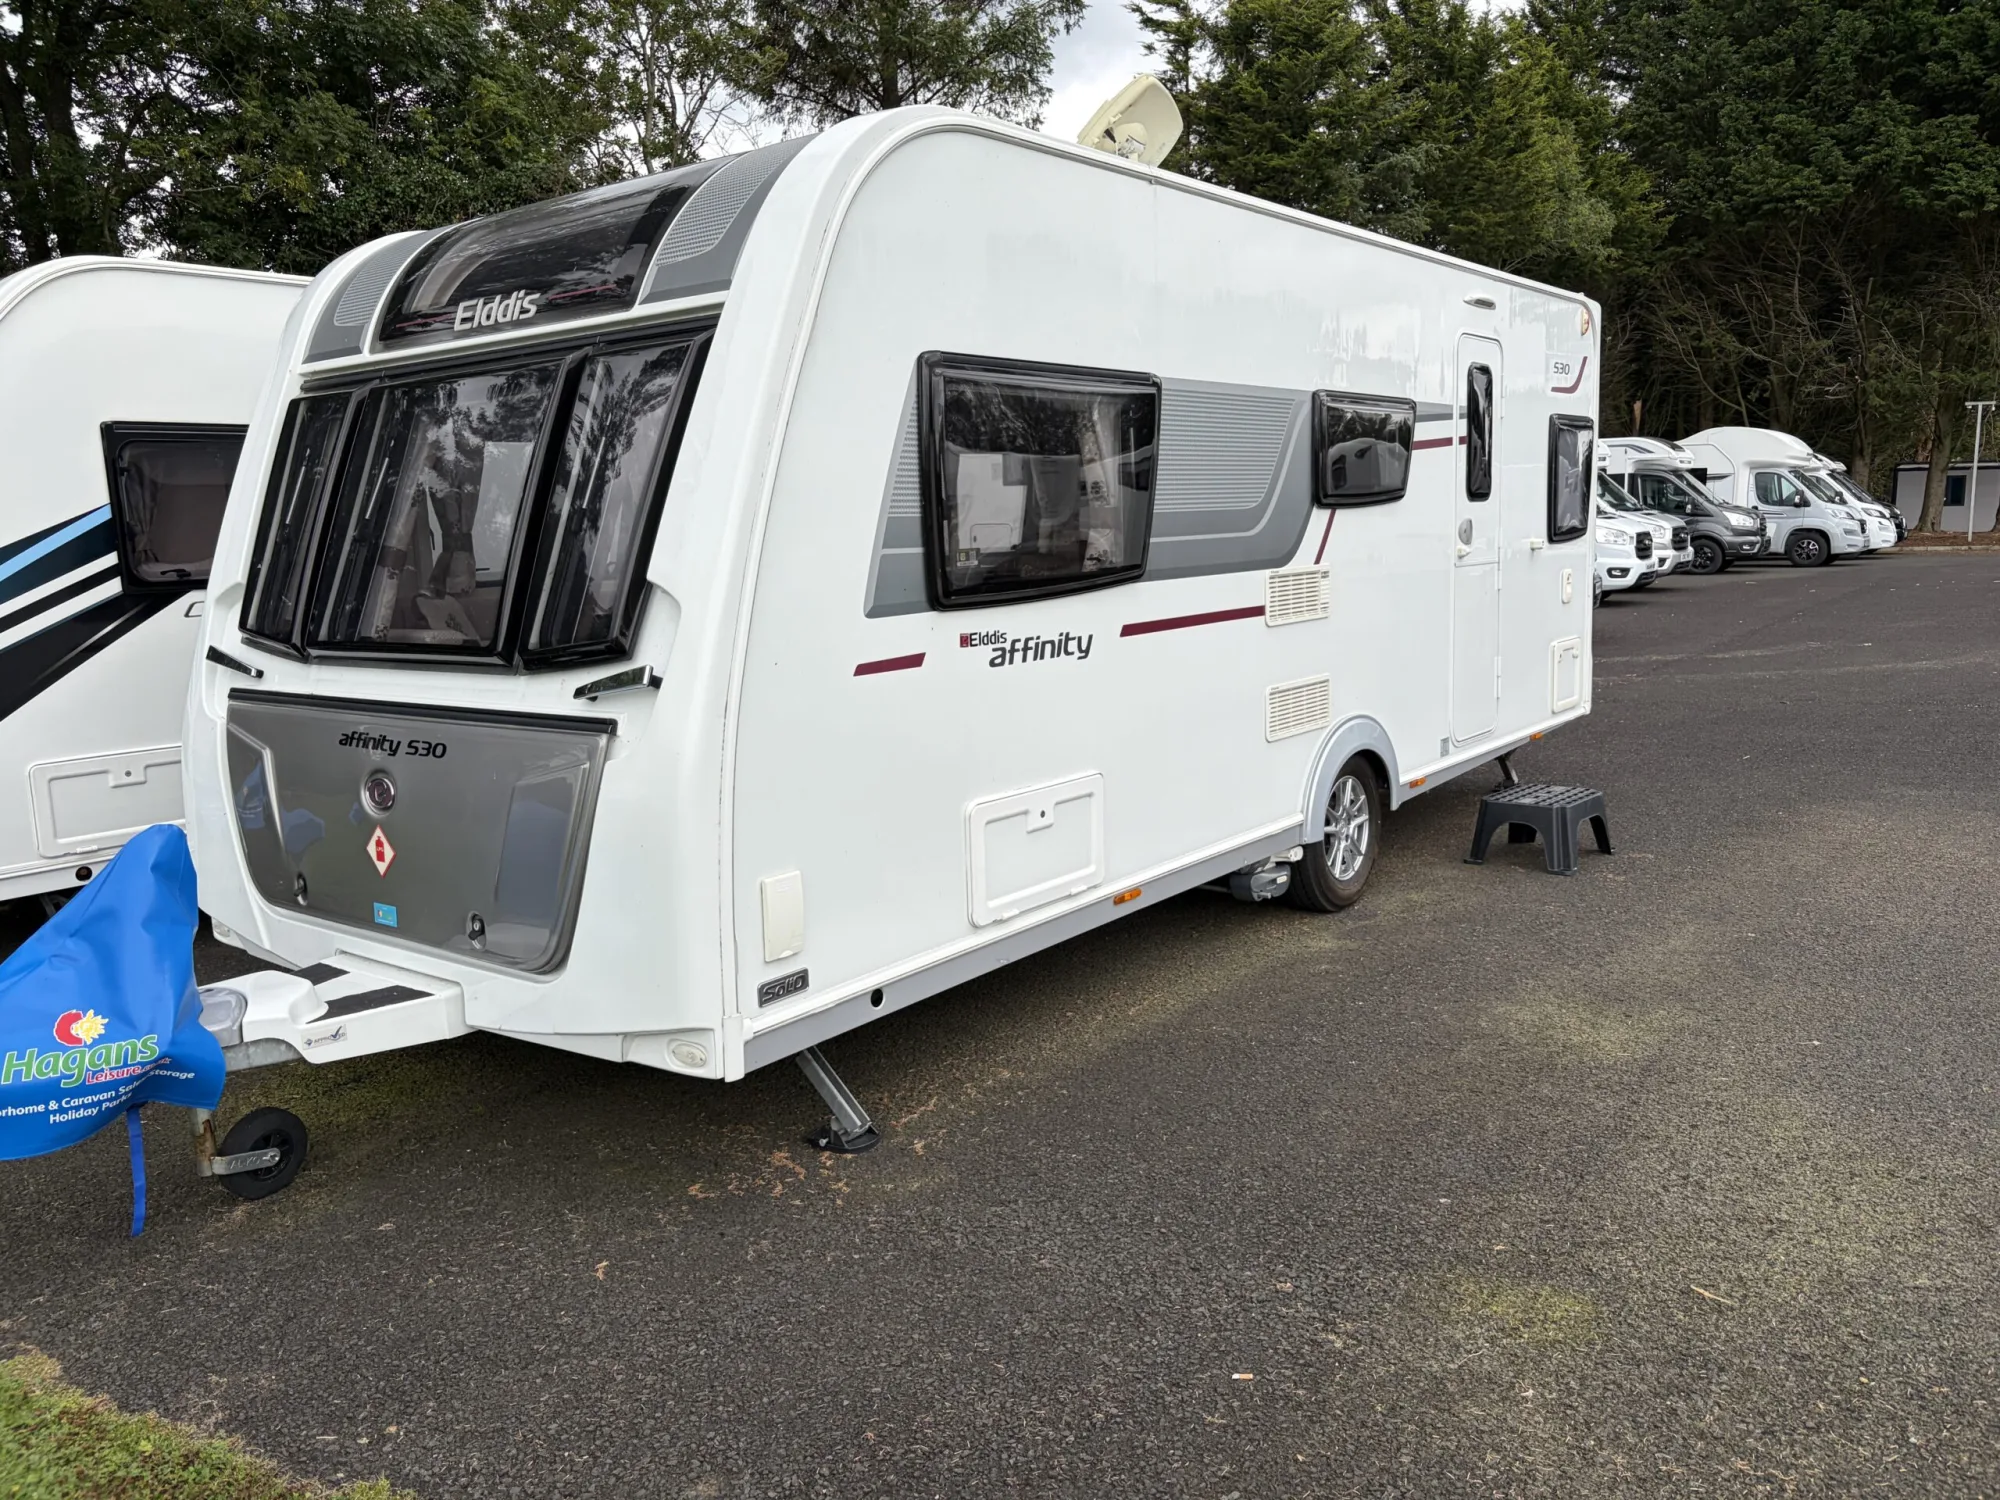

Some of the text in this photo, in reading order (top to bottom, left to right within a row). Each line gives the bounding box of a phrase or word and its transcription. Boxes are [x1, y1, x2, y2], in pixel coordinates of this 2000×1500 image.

[454, 289, 541, 332] Elddis
[1553, 361, 1570, 375] 530
[970, 630, 1008, 648] Elddis
[989, 631, 1094, 668] affinity
[338, 731, 448, 759] affinity 530
[1, 1034, 160, 1088] Hagans
[0, 1104, 46, 1118] rhome
[48, 1100, 59, 1111] &
[61, 1090, 116, 1109] Caravan
[49, 1106, 100, 1125] Holiday
